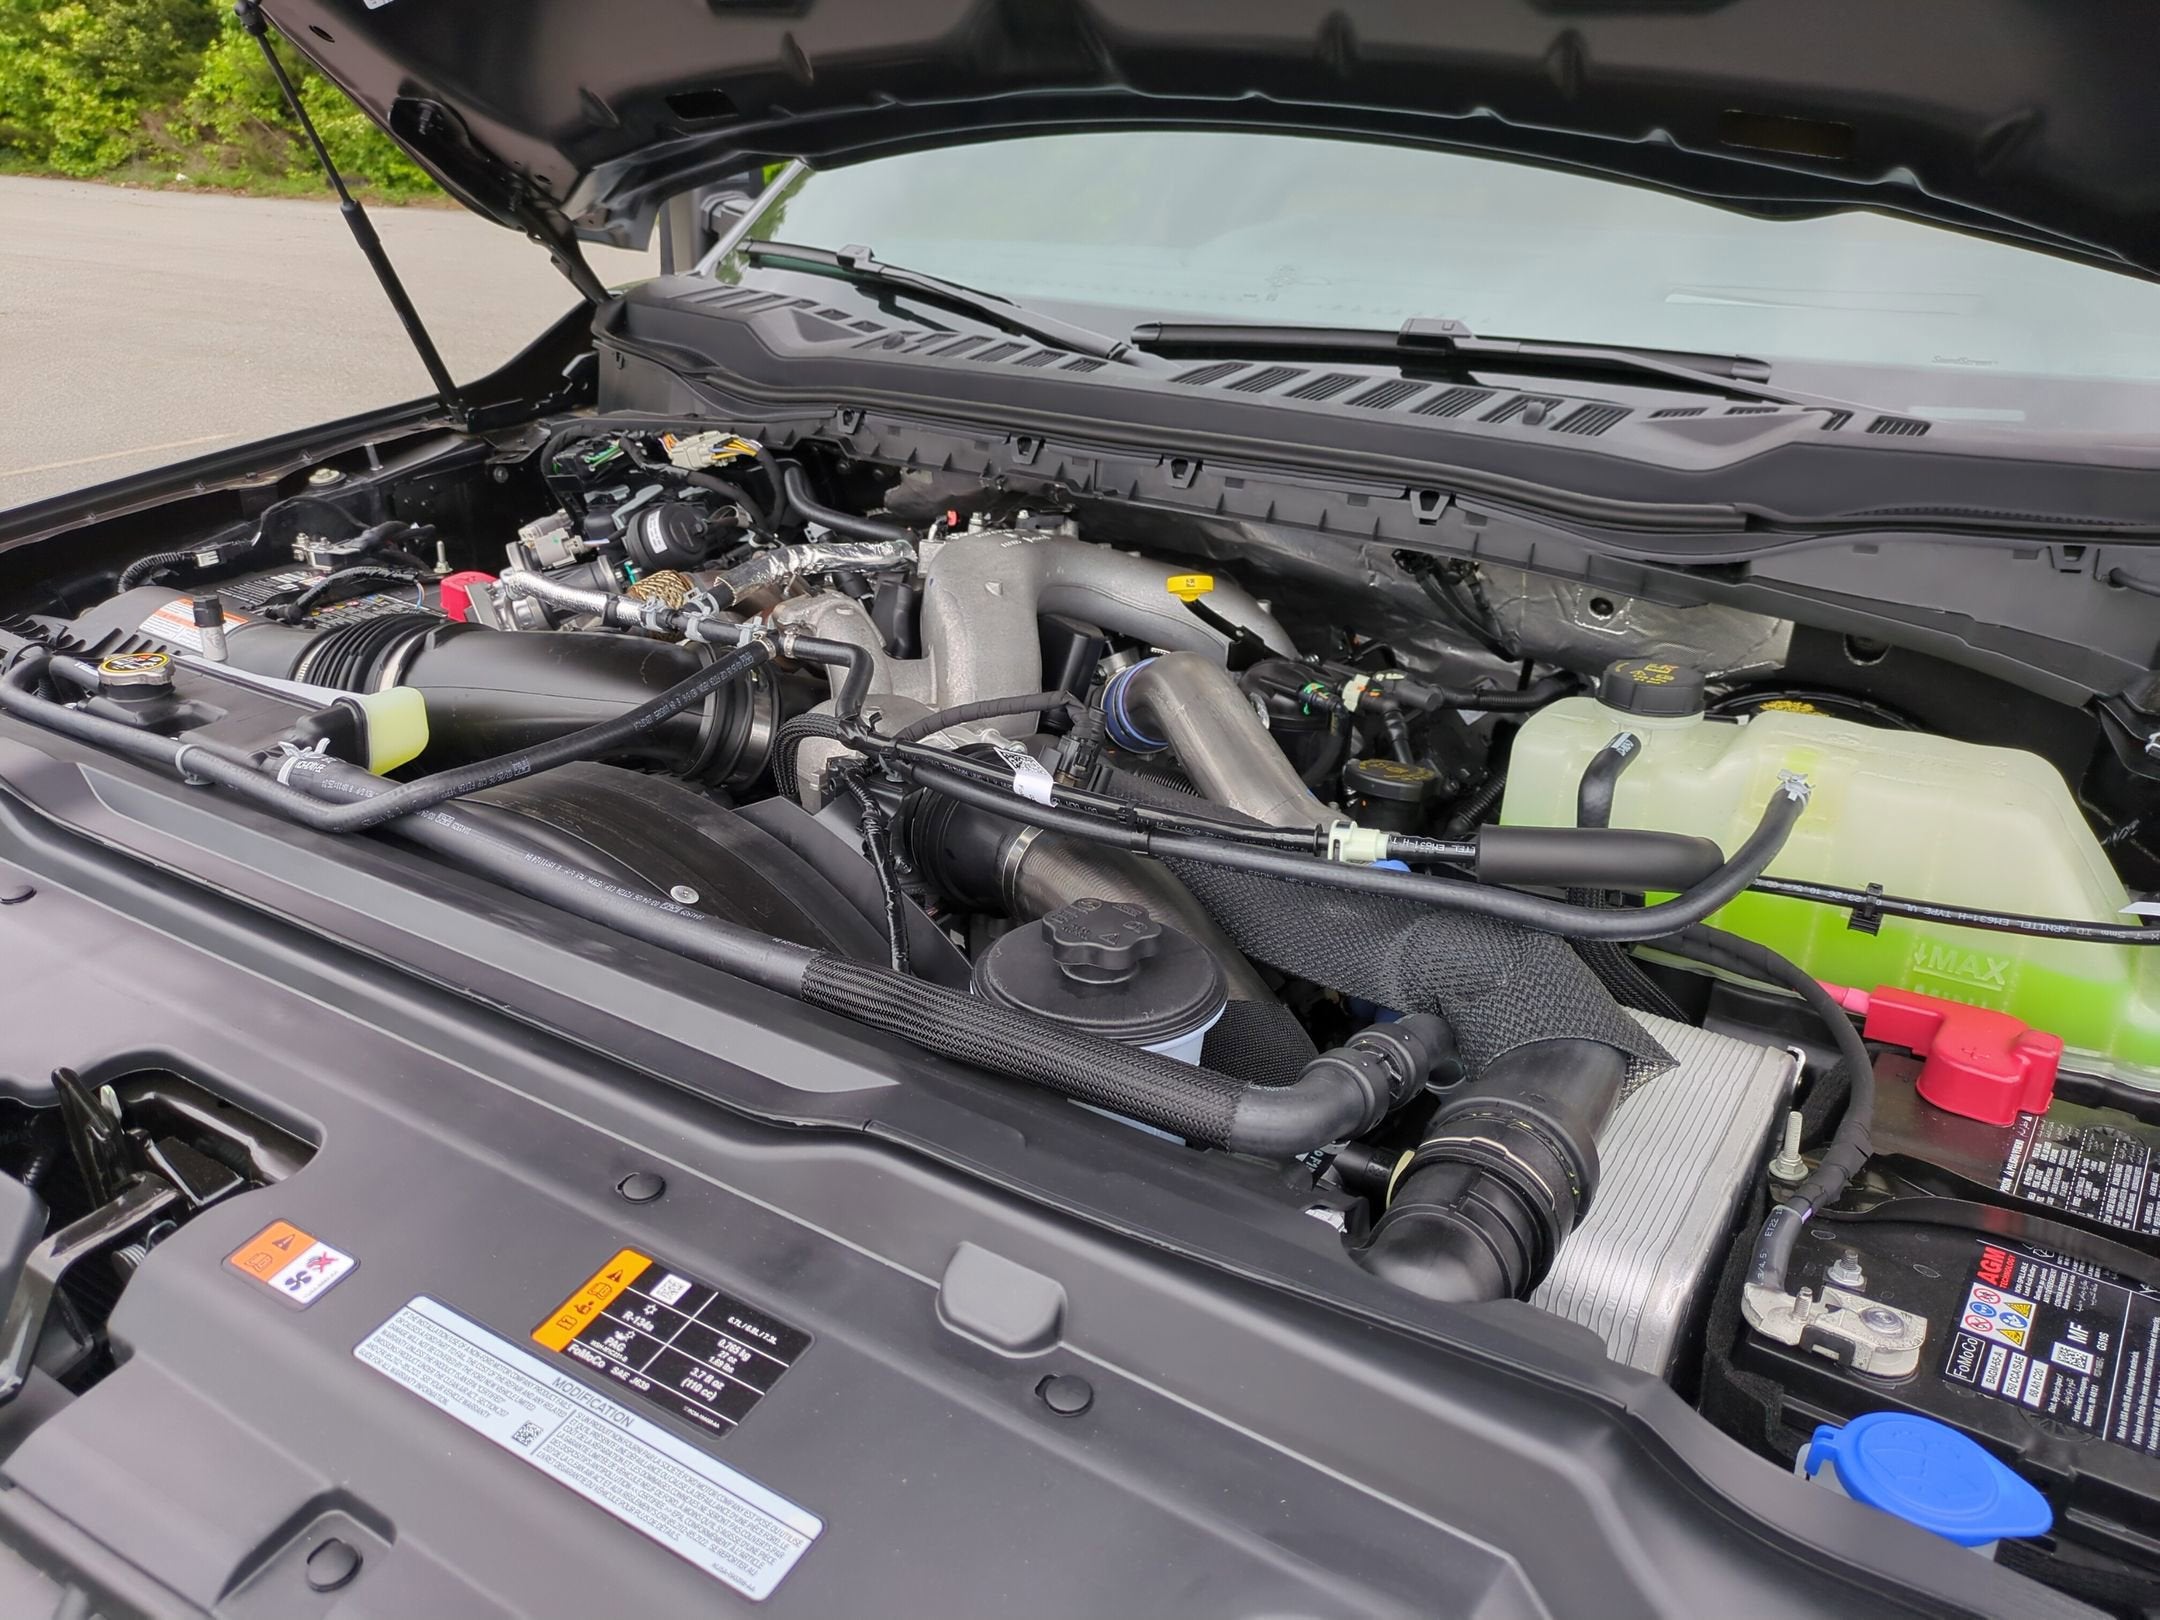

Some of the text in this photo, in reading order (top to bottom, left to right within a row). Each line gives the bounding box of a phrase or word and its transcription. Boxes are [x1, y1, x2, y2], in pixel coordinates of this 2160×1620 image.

[1450, 844, 1476, 854] ITEL
[1826, 889, 1883, 906] 0.23.26
[1902, 902, 1918, 912] UL
[1922, 905, 1952, 918] TYPE
[1957, 910, 2010, 928] EM631-H
[2015, 916, 2070, 936] ARNITEL
[1927, 944, 2010, 986] MAX
[1764, 1218, 1779, 1238] ET22
[1976, 1246, 2007, 1286] AGM
[2000, 1255, 2016, 1289] TECHNOLOGY
[2022, 1264, 2039, 1297] Lead Acid Battery
[622, 1310, 654, 1332] R-134a
[2067, 1322, 2089, 1344] MF
[604, 1336, 626, 1352] PAG
[717, 1338, 752, 1362] 0.765 kg
[568, 1343, 650, 1391] FoMoCo SAE J639
[717, 1350, 738, 1365] 27 oz
[721, 1362, 735, 1374] lbs
[1953, 1335, 1979, 1380] FoMoCo
[458, 1364, 472, 1374] THE
[468, 1369, 485, 1381] FORD
[493, 1384, 517, 1400] VEHICLE
[689, 1367, 707, 1379] 3.7
[710, 1379, 725, 1390] oz
[2005, 1355, 2025, 1395] 750 CCA/SAE
[2032, 1367, 2045, 1381] C20
[680, 1377, 718, 1402] (110 cc)
[2030, 1380, 2041, 1391] Ah
[553, 1377, 633, 1427] MODIFICATION
[2074, 1396, 2084, 1411] Motor
[2071, 1409, 2082, 1422] Ford
